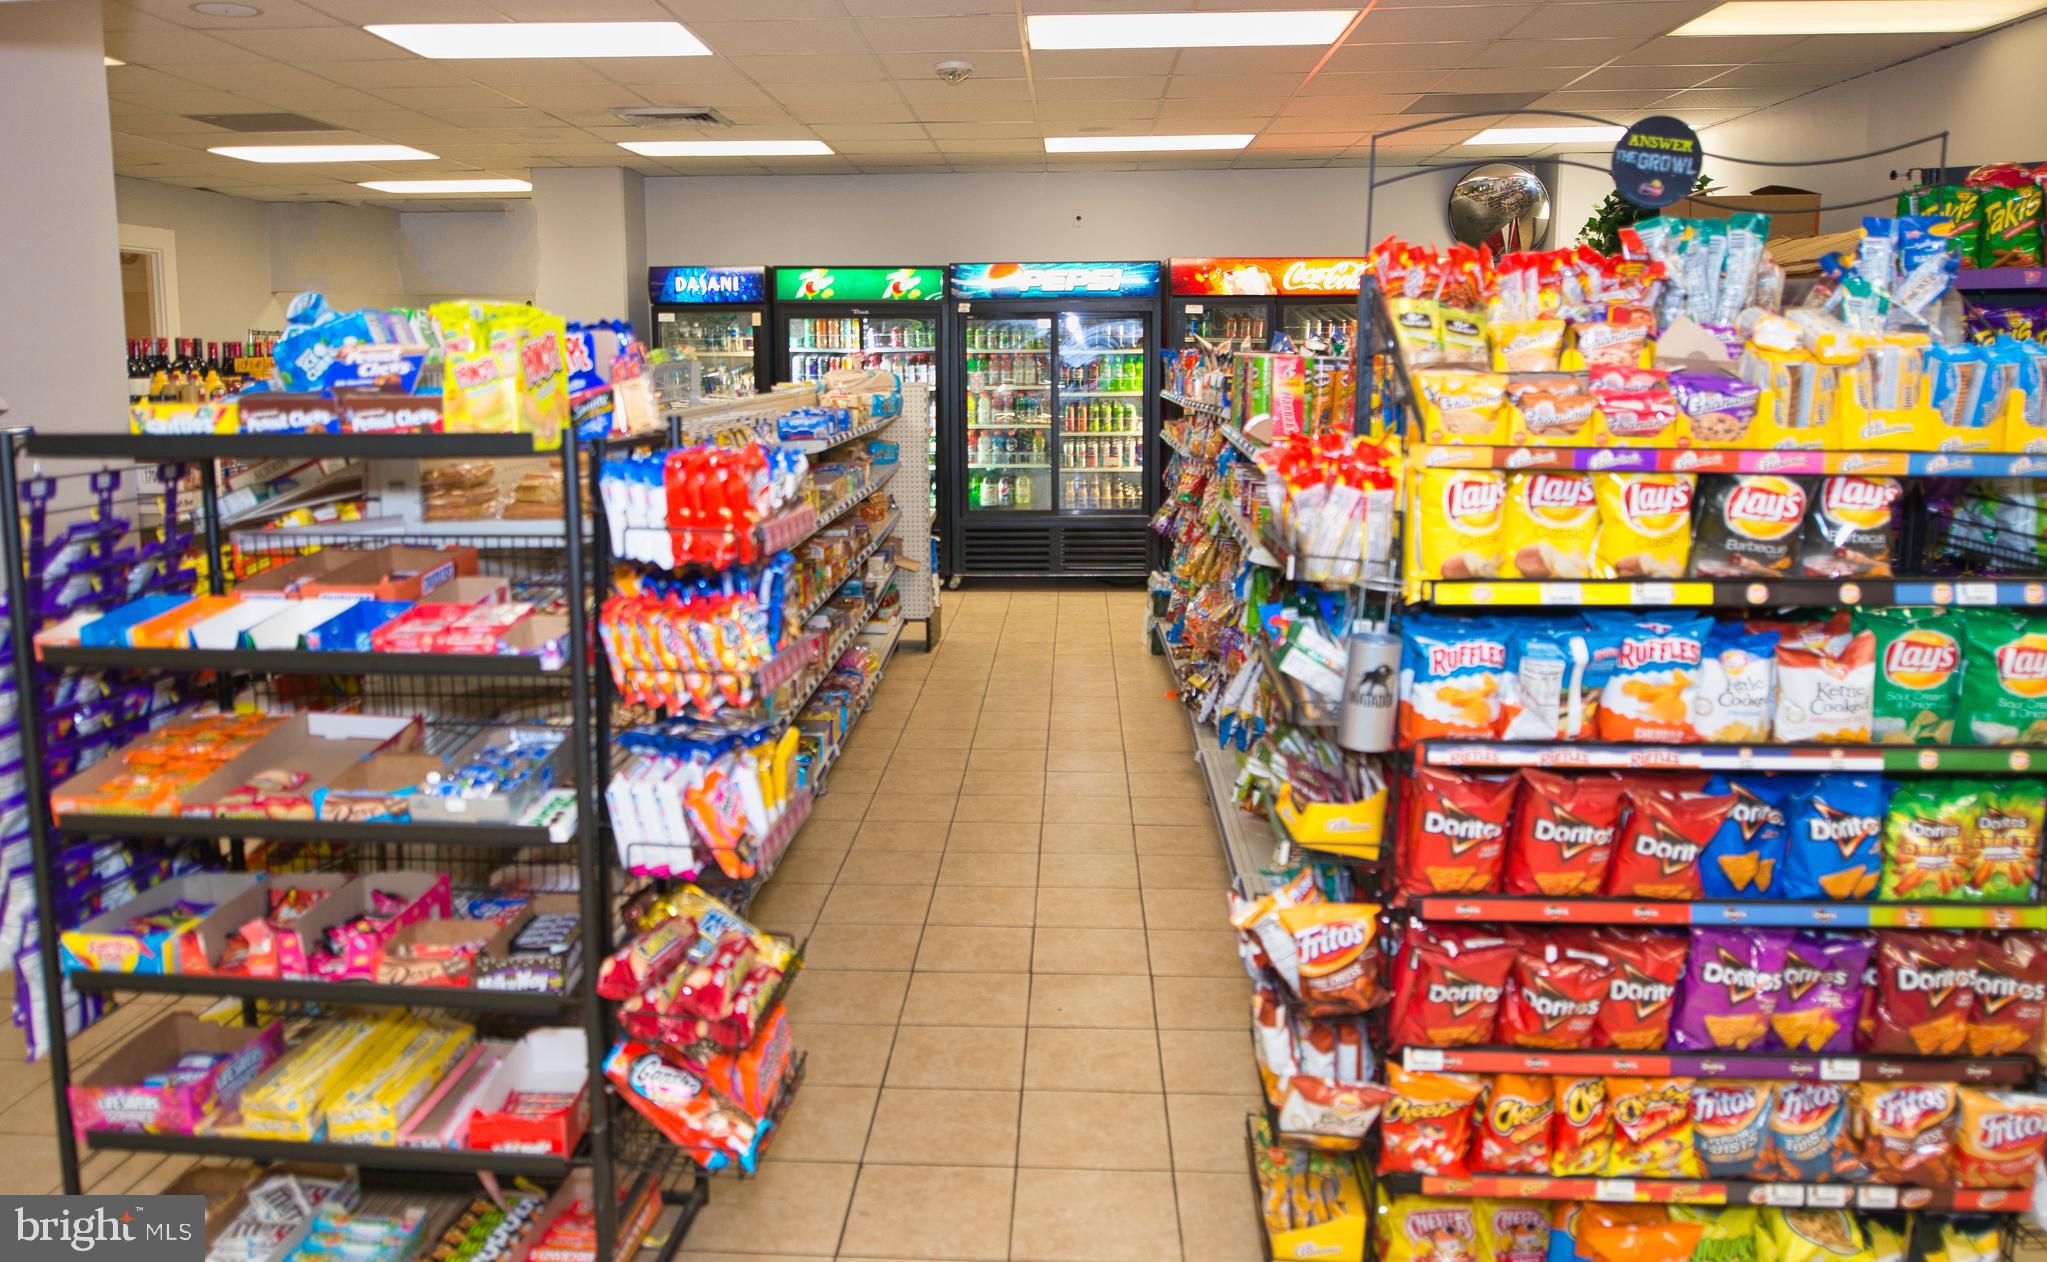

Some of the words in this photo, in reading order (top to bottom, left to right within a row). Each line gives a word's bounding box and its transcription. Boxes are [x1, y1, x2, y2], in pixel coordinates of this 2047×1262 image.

[1628, 133, 1693, 153] ANSWER
[1615, 148, 1635, 163] THE
[1635, 150, 1697, 176] GROWL
[1984, 190, 2042, 241] Takis
[675, 274, 739, 295] DASANI
[1020, 269, 1124, 291] PEPSI
[1532, 475, 1594, 507] Lay's
[1630, 483, 1690, 517] Lay's
[1730, 487, 1802, 522] Lay's
[1828, 479, 1899, 510] Lay's
[1725, 538, 1788, 556] Barbecue
[1432, 644, 1505, 674] RUFFLES
[1617, 638, 1701, 669] RUFFLES
[1887, 641, 1955, 673] Lay's
[2001, 647, 2047, 677] Lay
[1636, 835, 1701, 863] Dorit
[1298, 920, 1364, 965] Fritos
[1703, 961, 1783, 990] Doritos
[1783, 970, 1848, 986] oritos
[1898, 967, 1976, 991] Doritos
[1974, 976, 2046, 1001] oritos
[1523, 986, 1600, 1016] Doritos
[1873, 1085, 1948, 1126] Fritos
